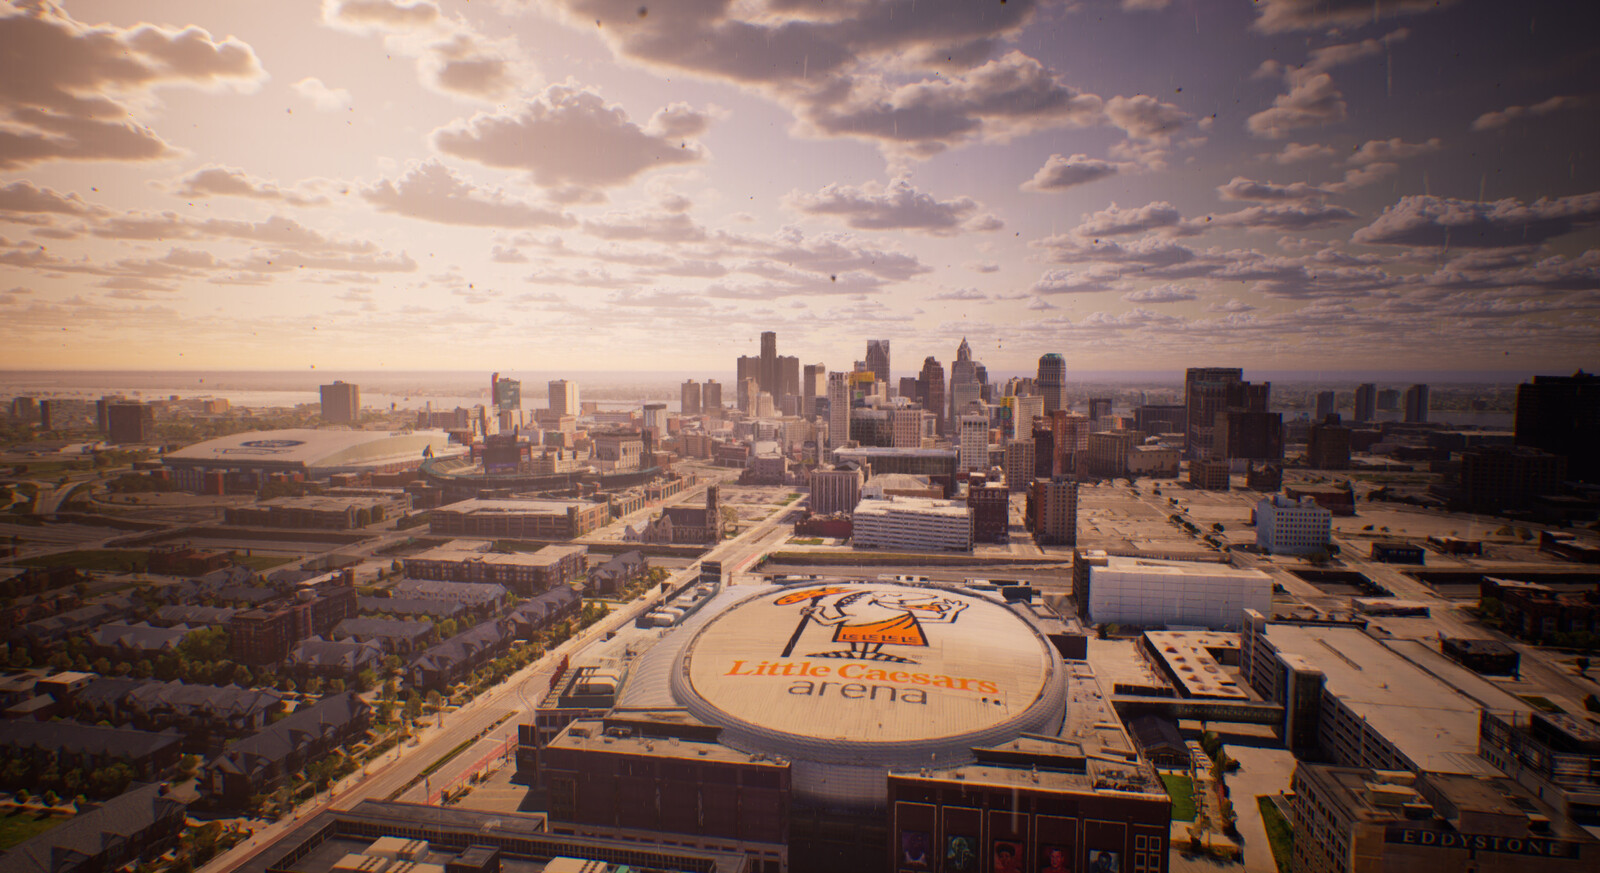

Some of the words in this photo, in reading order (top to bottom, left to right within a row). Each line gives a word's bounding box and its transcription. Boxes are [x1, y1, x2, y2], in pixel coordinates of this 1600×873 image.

[723, 660, 831, 677] Little
[838, 664, 999, 694] Caesars
[788, 680, 927, 705] arena
[1401, 829, 1561, 856] EDDYSTONE
